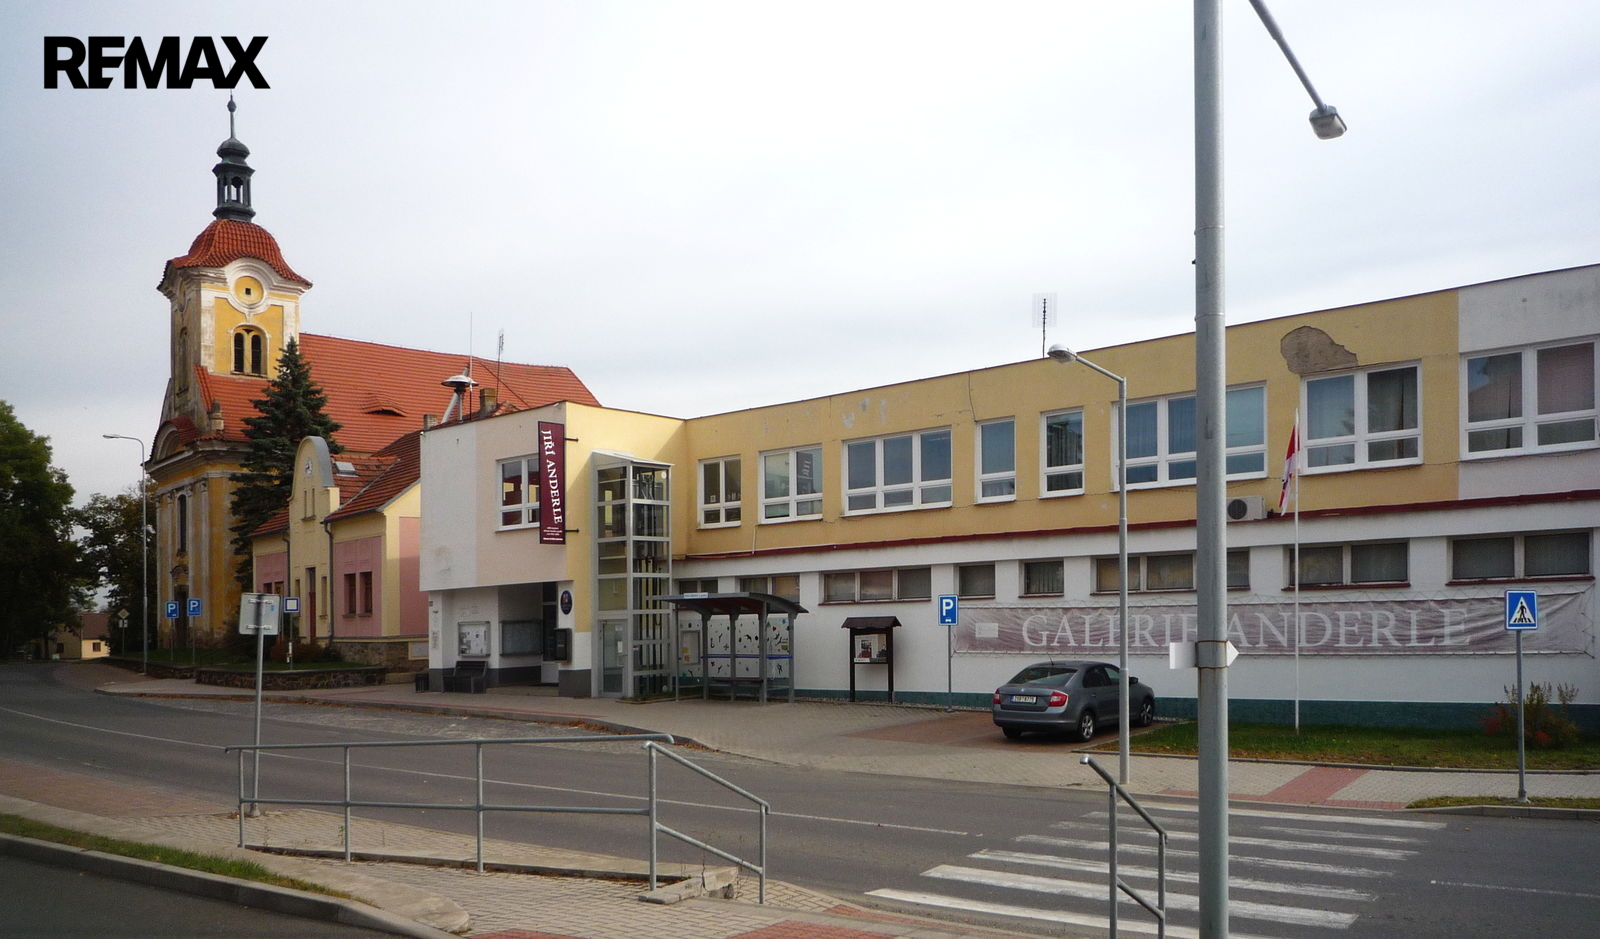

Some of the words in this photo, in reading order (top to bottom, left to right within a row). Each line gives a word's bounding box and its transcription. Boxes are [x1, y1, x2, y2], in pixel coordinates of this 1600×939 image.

[541, 430, 556, 456] JIŘÍ
[547, 459, 563, 524] ANDERLE
[168, 603, 176, 613] P
[190, 600, 199, 611] P
[942, 599, 954, 616] P
[1226, 607, 1471, 648] ANDERLE
